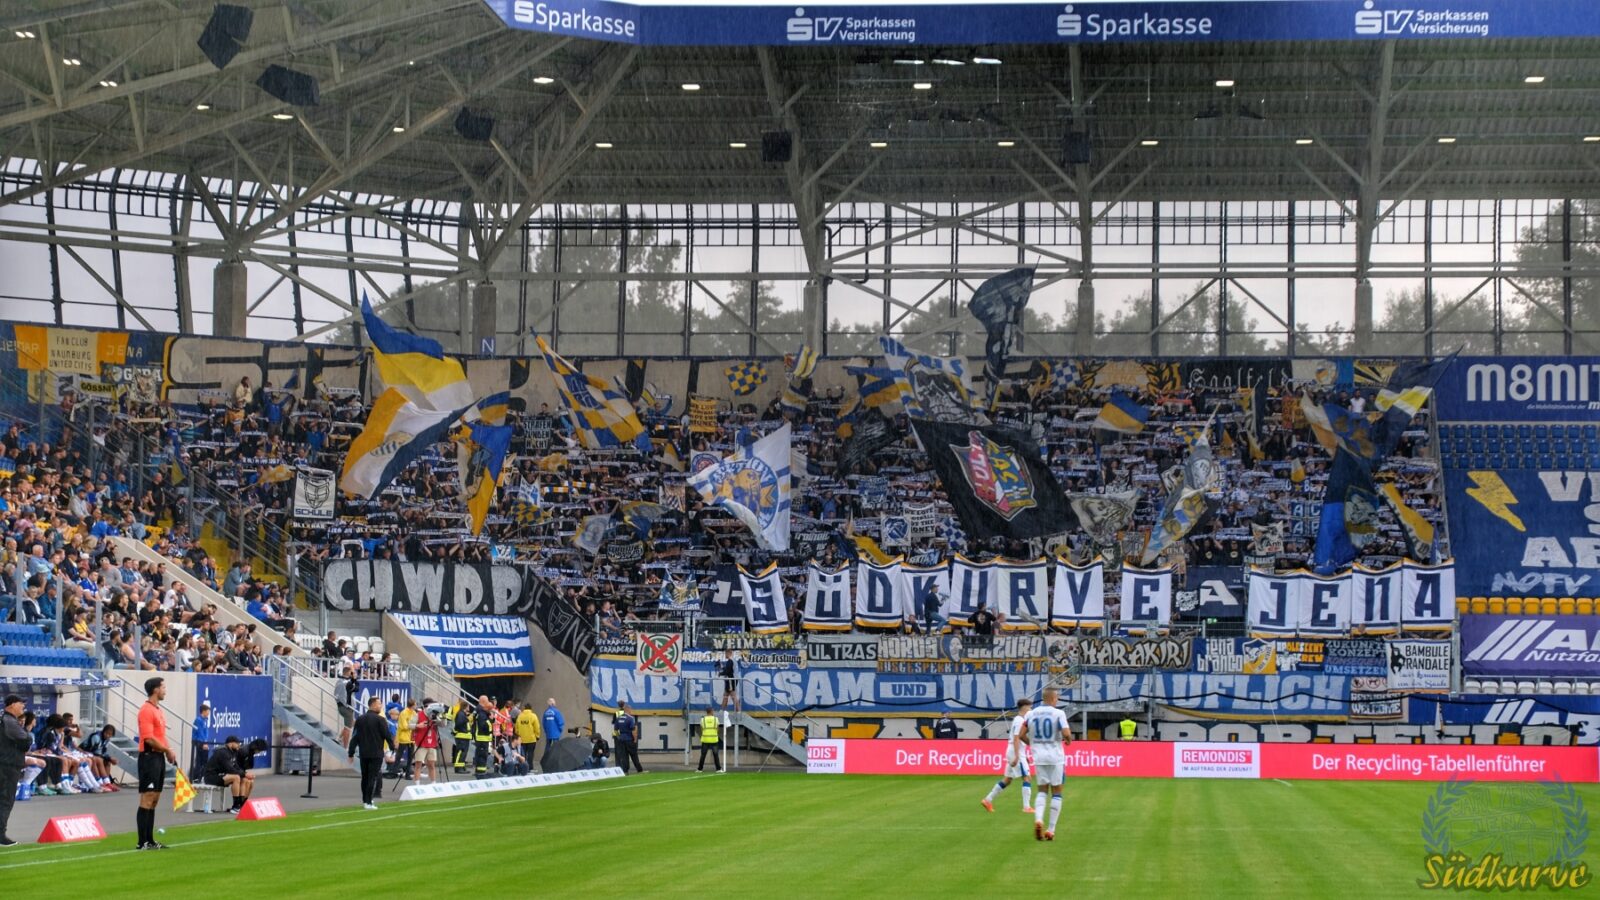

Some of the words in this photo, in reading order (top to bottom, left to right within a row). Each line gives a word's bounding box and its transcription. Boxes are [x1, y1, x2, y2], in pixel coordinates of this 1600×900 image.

[536, 4, 636, 37] Sparkasse
[846, 18, 915, 30] Sparkassen
[1416, 10, 1489, 22] Sparkassen
[1086, 13, 1212, 40] Sparkasse
[1409, 23, 1489, 36] Versicherung
[839, 29, 916, 42] Versicherung
[442, 616, 528, 635] INVESTOREN
[808, 643, 877, 660] ULTRAS
[1405, 645, 1449, 657] BAMBULE
[446, 652, 523, 670] FUSSBALL
[1405, 658, 1449, 670] RANDALE
[890, 682, 928, 697] UND
[212, 706, 241, 733] Sparkasse
[1033, 718, 1053, 739] 10
[896, 750, 924, 766] Der
[1182, 751, 1247, 763] REMONDIS
[1312, 753, 1341, 770] Der
[1346, 753, 1546, 776] Recycling-Tabellenführer
